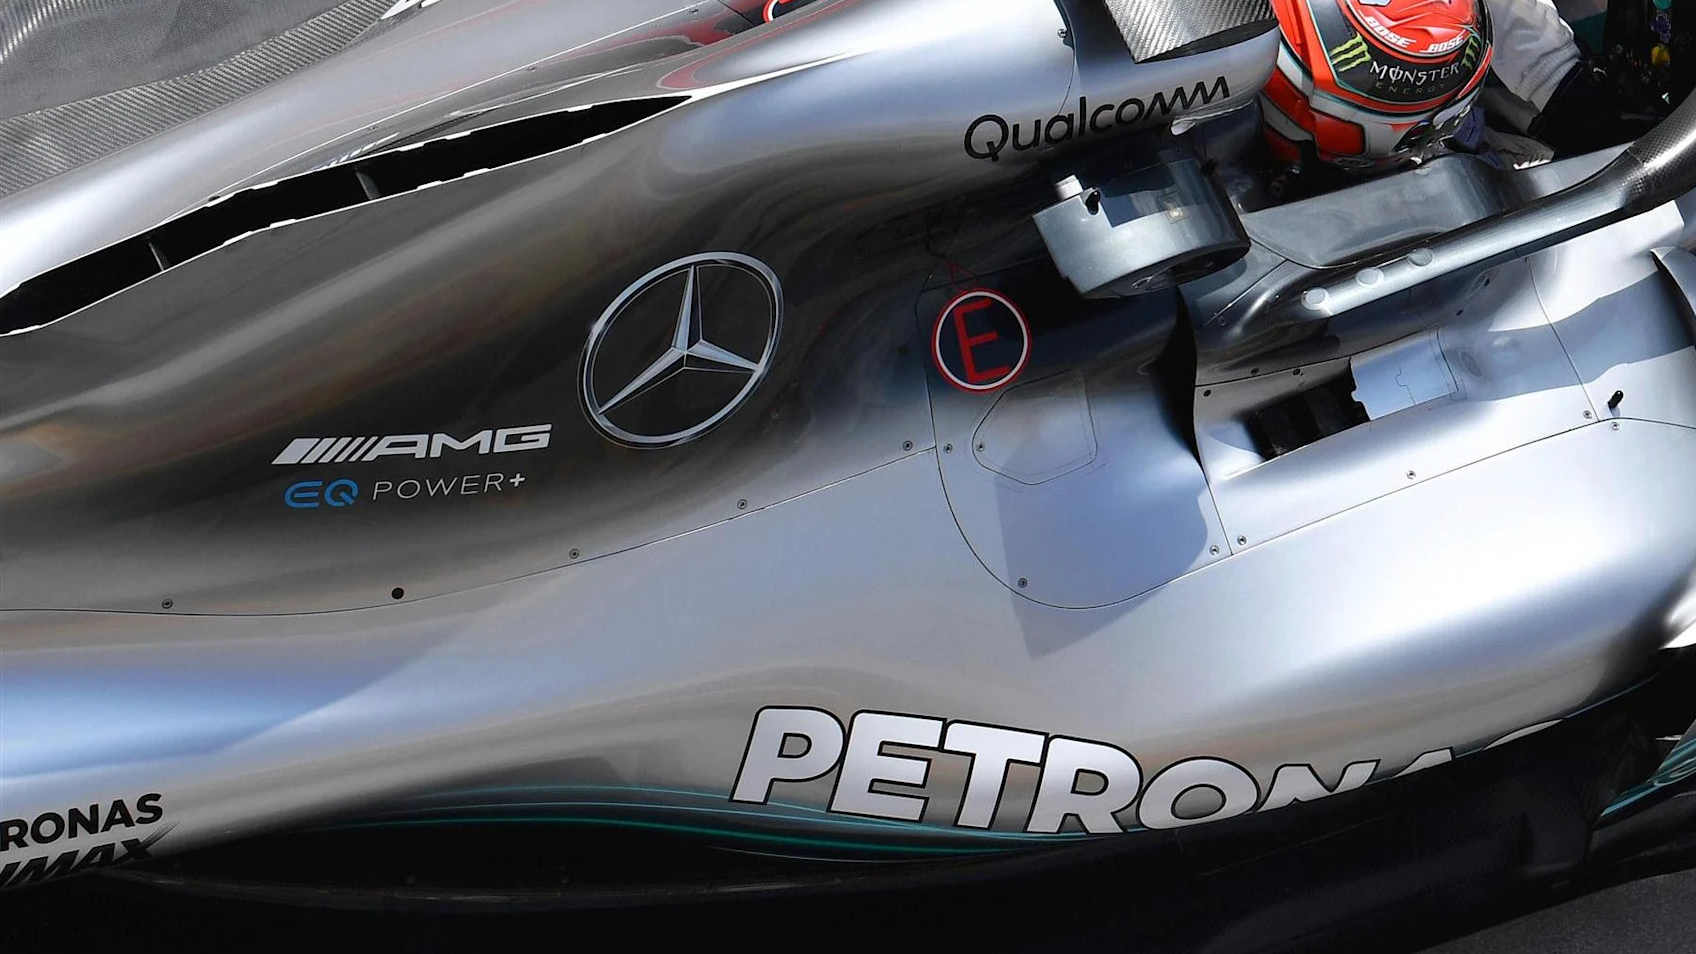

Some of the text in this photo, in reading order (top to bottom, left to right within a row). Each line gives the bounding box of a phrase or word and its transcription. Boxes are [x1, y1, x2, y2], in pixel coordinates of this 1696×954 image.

[1363, 16, 1416, 48] BOSE
[1424, 34, 1464, 53] BOSE
[964, 76, 1230, 163] Qualcomm
[952, 296, 1010, 384] E
[360, 424, 552, 462] AMG
[283, 472, 525, 508] EQ POWER+
